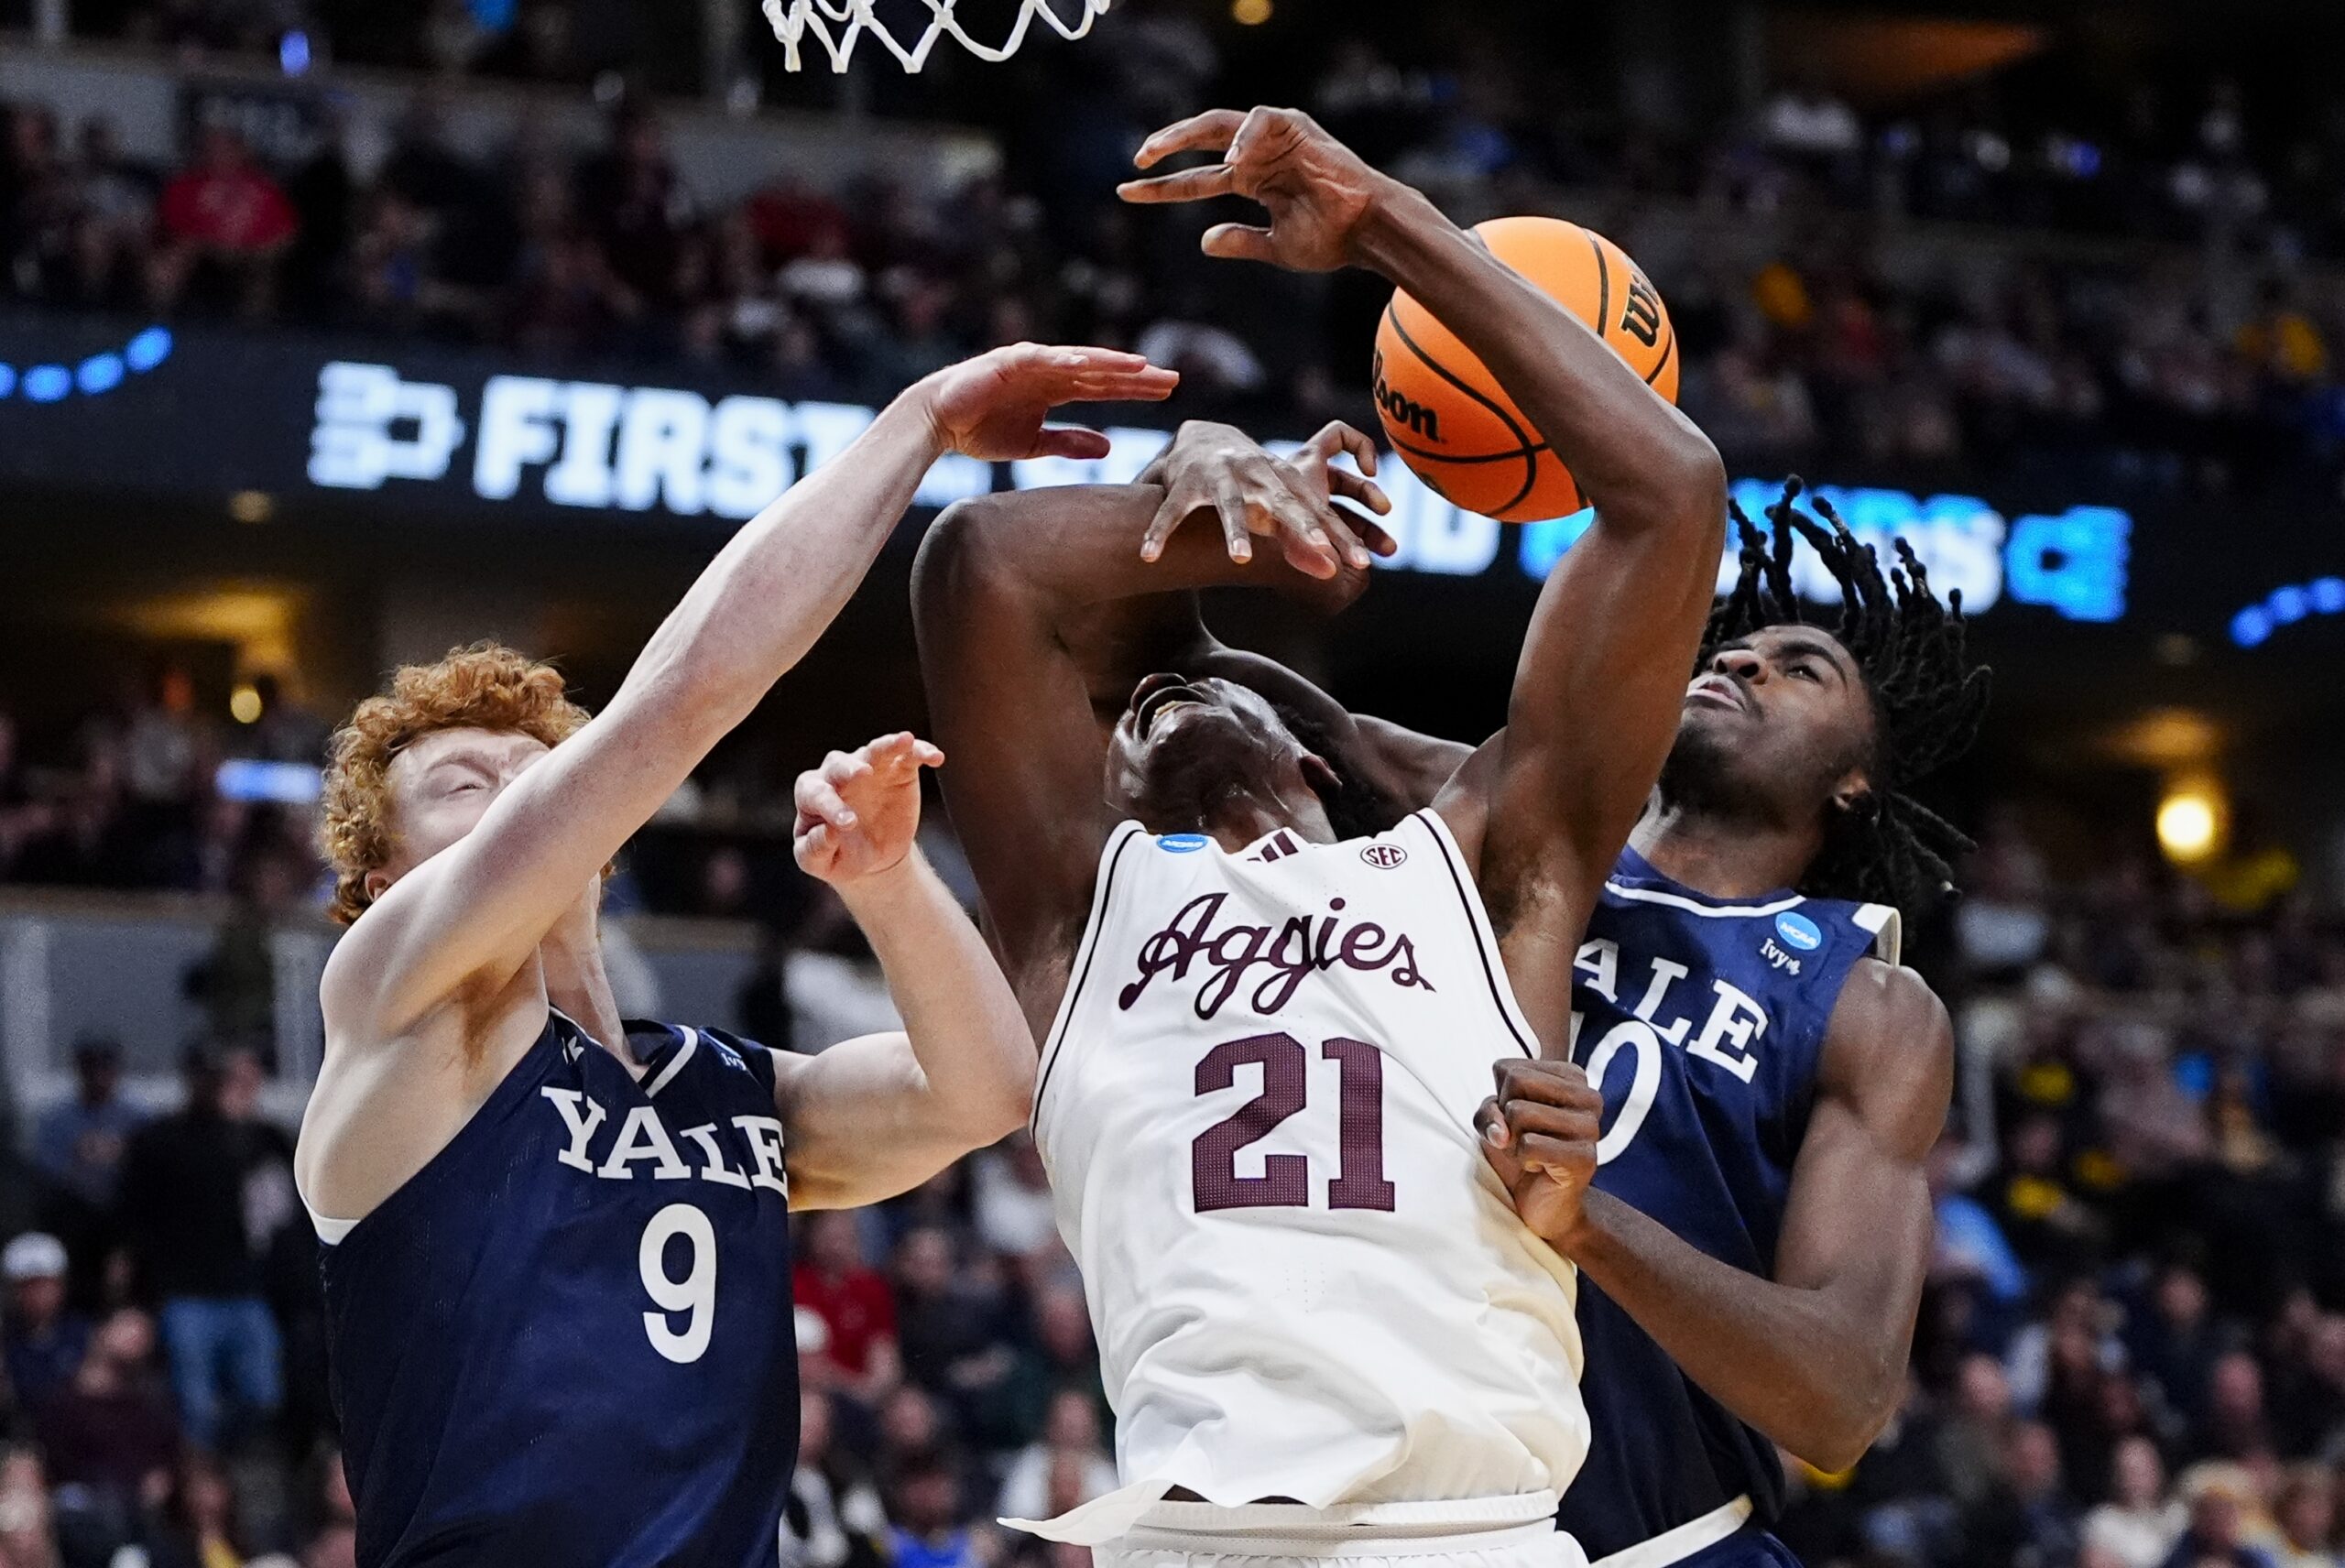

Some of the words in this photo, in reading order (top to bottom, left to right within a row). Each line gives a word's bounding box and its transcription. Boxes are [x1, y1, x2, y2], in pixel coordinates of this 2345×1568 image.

[1620, 272, 1660, 348] Wi
[1374, 349, 1441, 443] lson
[1365, 846, 1402, 866] SEC
[1118, 891, 1437, 1021] Aggies
[1779, 921, 1818, 948] NCAA
[1572, 936, 1770, 1085] ALE
[540, 1085, 790, 1202] YALE
[1192, 1031, 1396, 1214] 21
[1568, 1010, 1663, 1167] 0
[638, 1203, 717, 1365] 9
